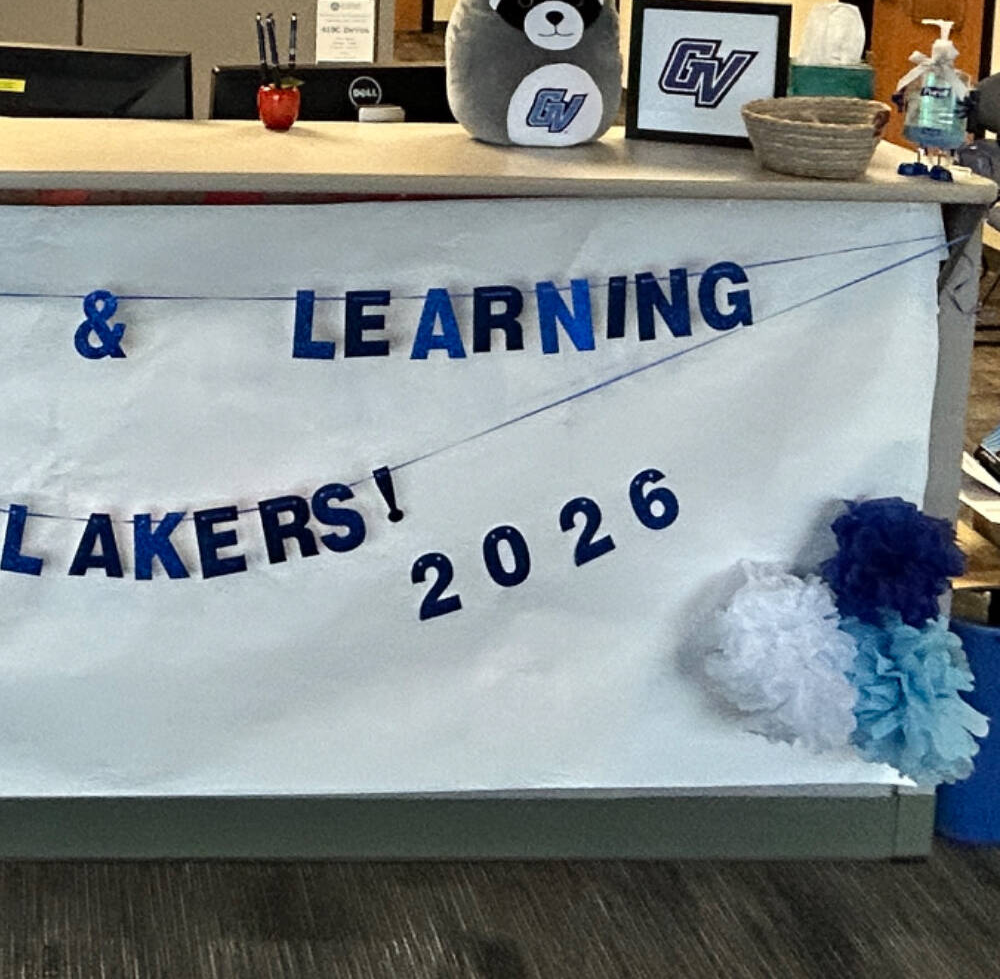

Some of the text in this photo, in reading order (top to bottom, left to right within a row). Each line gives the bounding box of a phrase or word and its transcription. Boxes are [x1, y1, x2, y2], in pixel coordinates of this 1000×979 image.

[526, 88, 588, 133] GV
[658, 38, 759, 108] GV
[73, 289, 128, 360] &
[291, 260, 754, 360] LEARNING
[0, 465, 405, 580] LAKERS!
[410, 468, 679, 620] 2026
